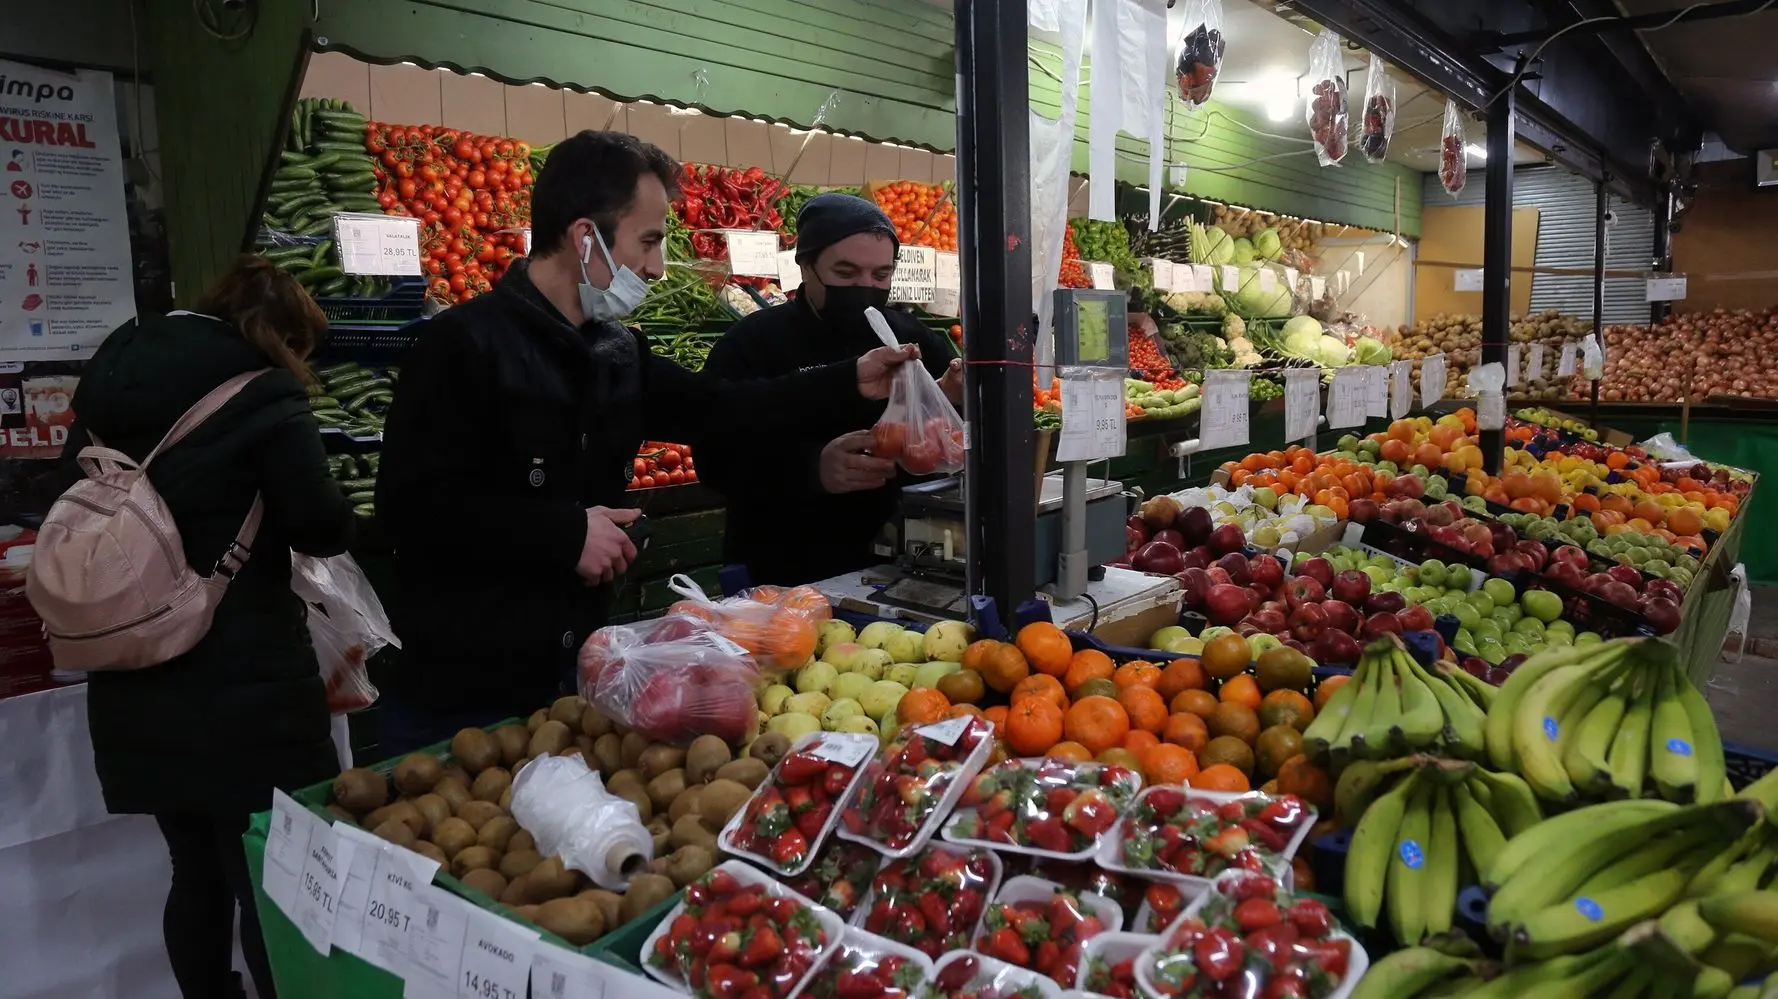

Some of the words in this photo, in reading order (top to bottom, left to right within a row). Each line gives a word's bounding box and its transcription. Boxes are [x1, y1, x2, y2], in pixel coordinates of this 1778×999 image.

[0, 117, 96, 149] KURAL
[384, 248, 405, 257] 28,95
[407, 248, 417, 257] TL
[898, 248, 925, 264] ELDIVEN
[304, 872, 321, 902] 15,95
[323, 891, 334, 914] TL
[369, 899, 401, 928] 20,95
[478, 939, 514, 963] AVOKADO
[466, 970, 499, 999] 14,95
